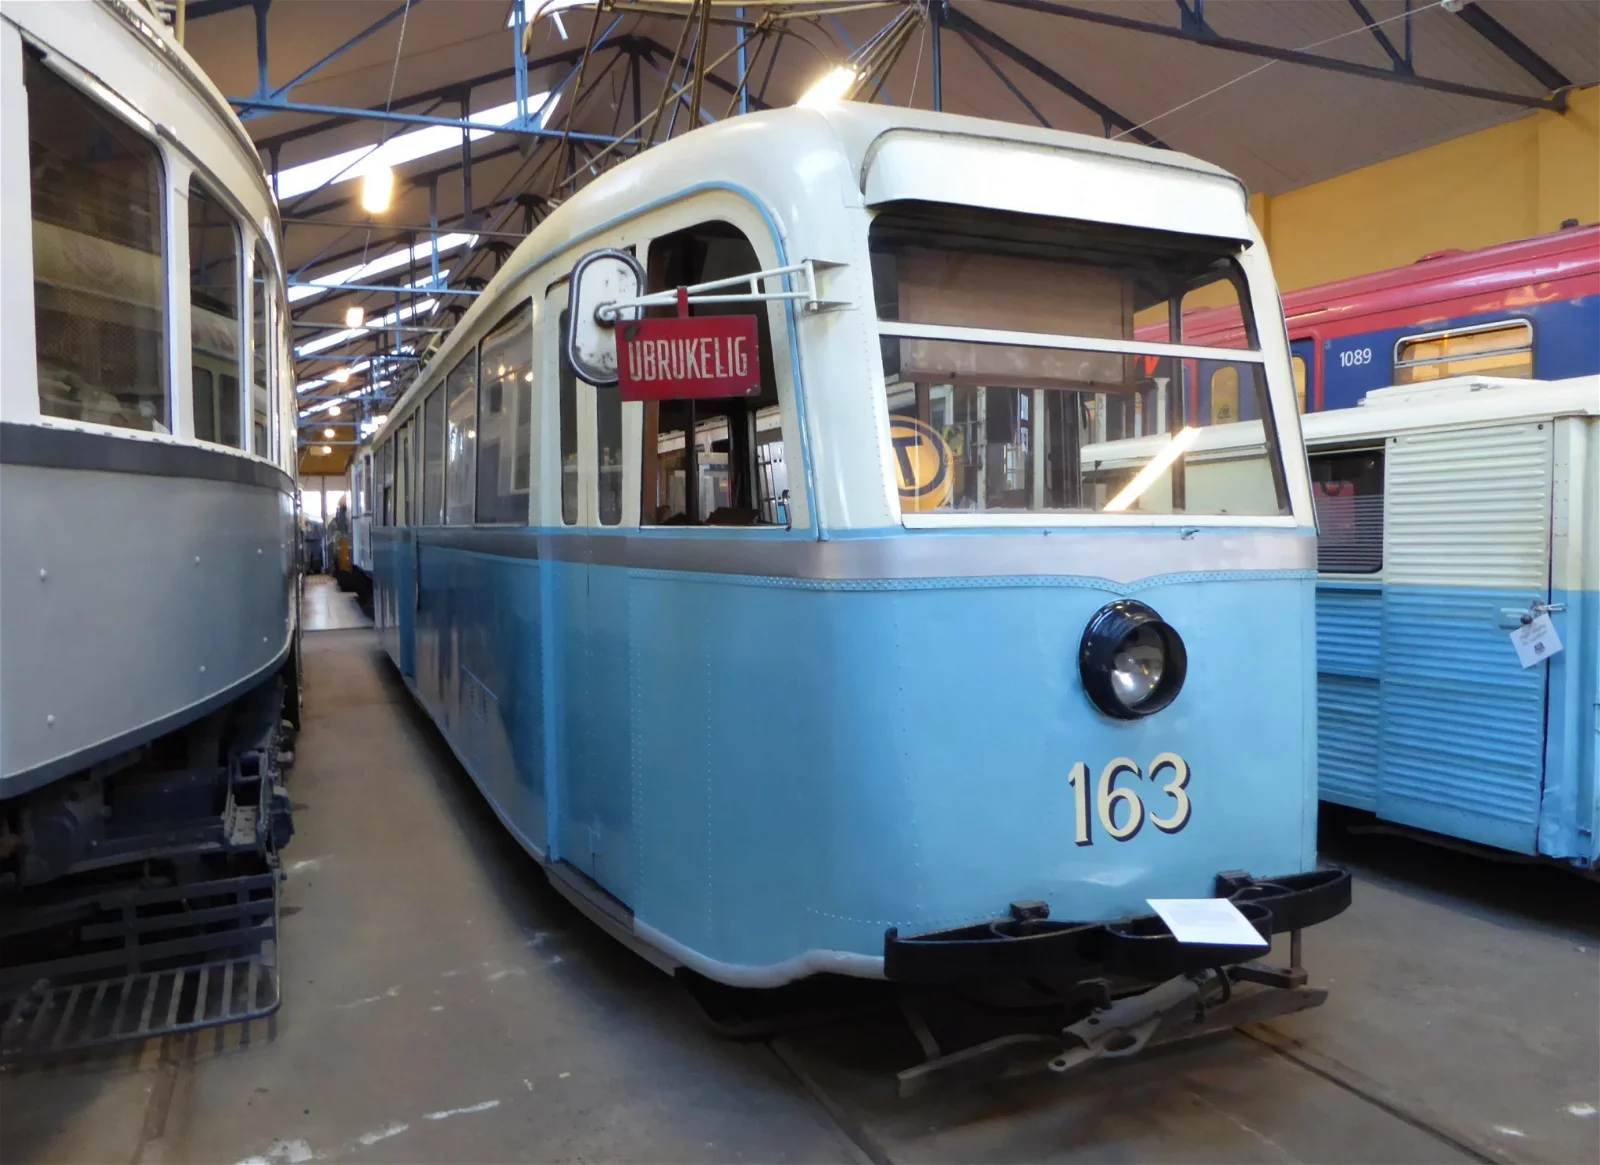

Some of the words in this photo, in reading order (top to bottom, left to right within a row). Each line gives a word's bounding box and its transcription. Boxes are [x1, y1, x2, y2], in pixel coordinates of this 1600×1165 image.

[627, 336, 748, 382] UBRUKELIG
[1339, 347, 1372, 368] 1089
[1068, 751, 1192, 848] 163
